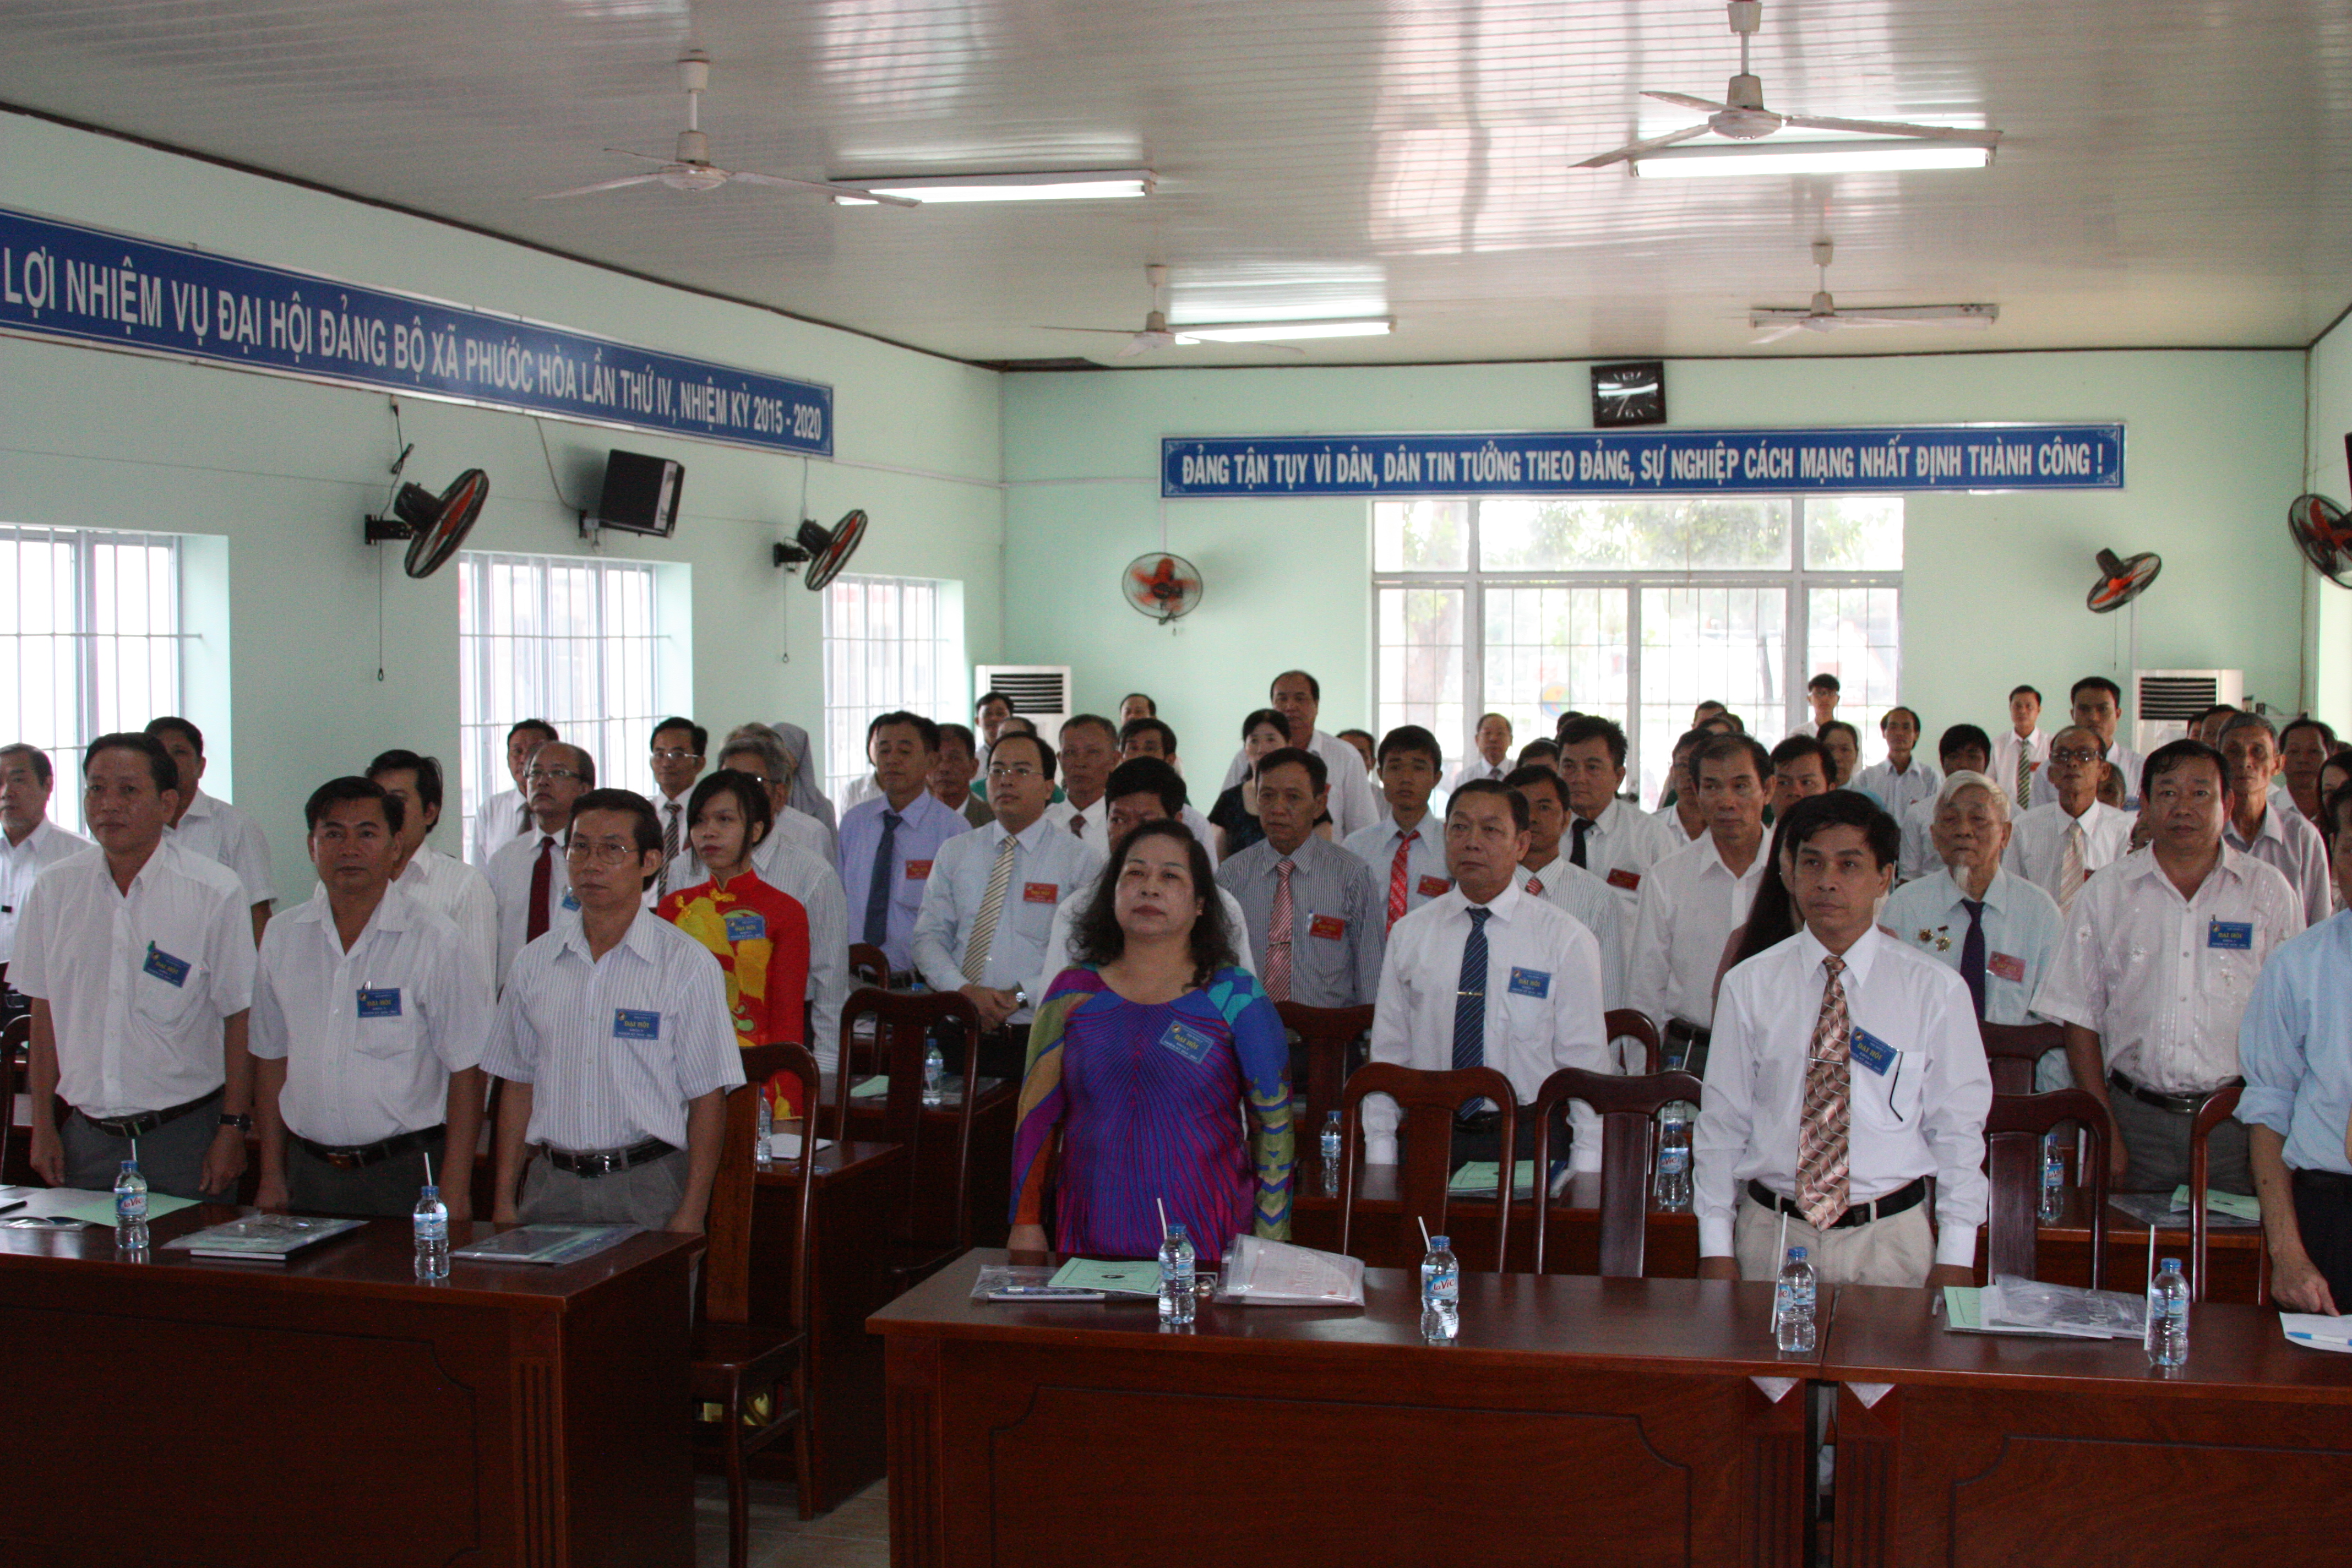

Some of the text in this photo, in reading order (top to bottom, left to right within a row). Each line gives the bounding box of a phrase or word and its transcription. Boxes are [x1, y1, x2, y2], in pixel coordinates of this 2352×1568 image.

[4, 247, 56, 318] LỢI
[66, 256, 162, 334] NHIỆM
[171, 281, 209, 346] VỤ
[218, 290, 261, 354] ĐẠI
[270, 291, 312, 363] HỘI
[320, 294, 386, 366] ĐẢNG
[394, 315, 426, 382] BỘ
[432, 324, 459, 380] XÃ
[466, 337, 533, 394] PHƯỚC
[538, 341, 577, 401] HÒA
[582, 347, 616, 407] LẦN
[620, 364, 655, 413] THỨ
[657, 378, 677, 424] IV,
[680, 375, 727, 430] NHIỆM
[732, 383, 750, 427] KỲ
[753, 397, 783, 434] 2015
[793, 404, 821, 440] 2020
[1183, 444, 1229, 484] ĐẢNG
[1234, 447, 1269, 489] TẬN
[1274, 454, 1309, 489] TỤY
[1314, 447, 1331, 483] VÌ
[1337, 446, 1379, 488] DÂN,
[1384, 445, 1421, 482] DÂN
[1425, 451, 1456, 482] TIN
[1460, 441, 1522, 482] TƯỞNG
[1526, 450, 1576, 482] THEO
[1580, 439, 1635, 486] ĐẢNG,
[1641, 444, 1667, 484] SỰ
[1671, 440, 1740, 485] NGHIỆP
[1744, 440, 1794, 479] CÁCH
[1800, 447, 1855, 484] MẠNG
[1860, 434, 1910, 477] NHẤT
[1916, 446, 1962, 484] ĐỊNH
[1968, 435, 2034, 477] THÀNH
[2038, 435, 2090, 476] CÔNG
